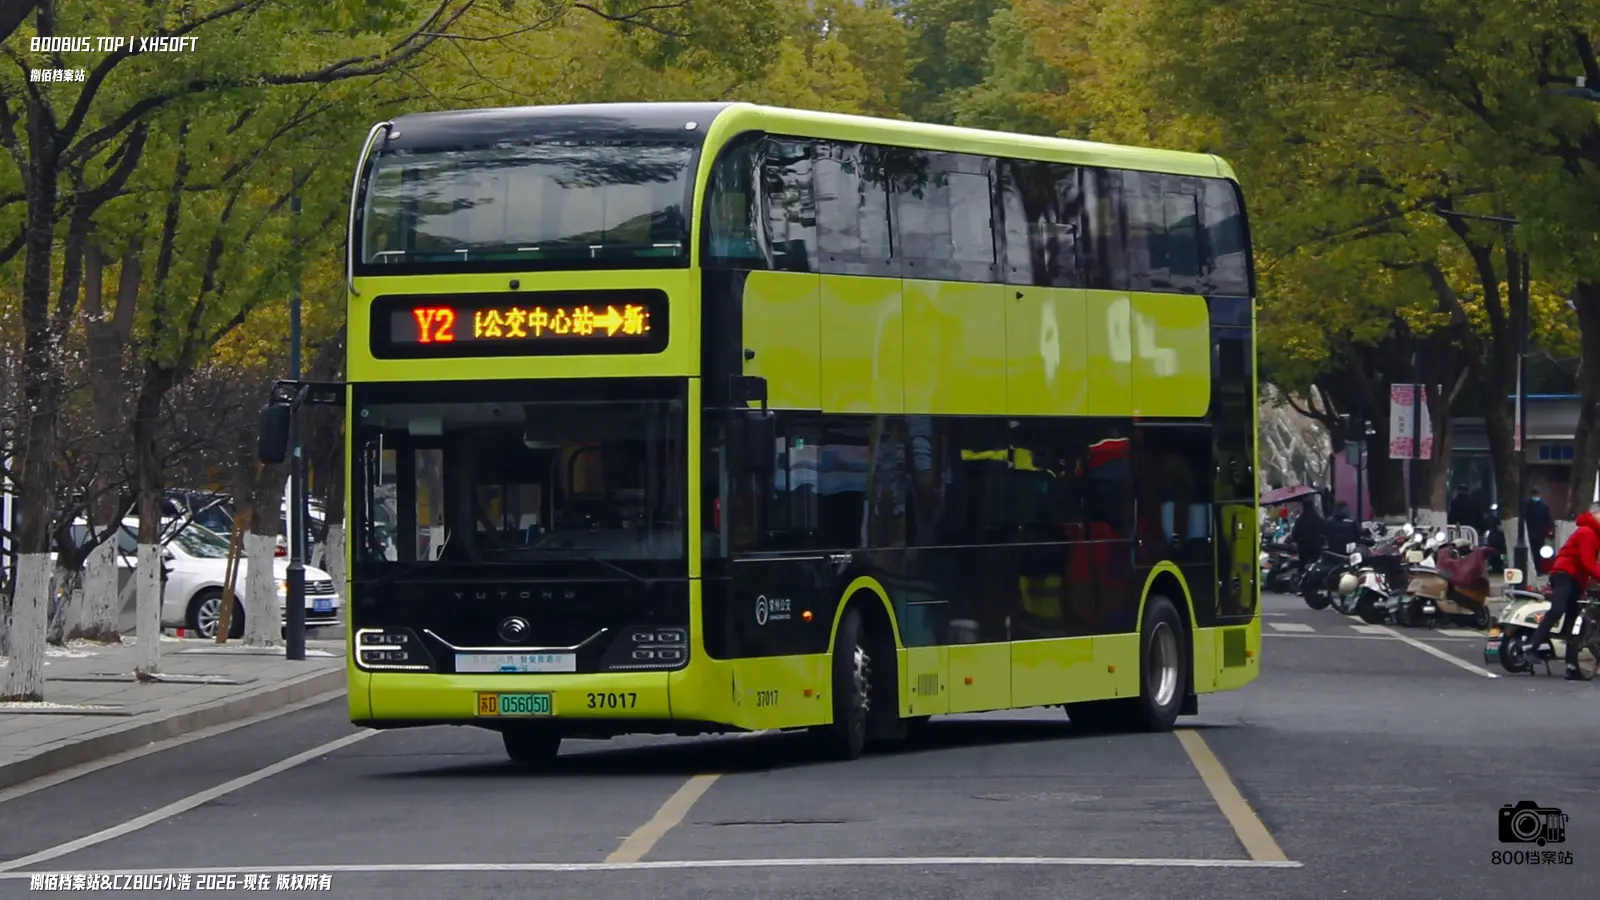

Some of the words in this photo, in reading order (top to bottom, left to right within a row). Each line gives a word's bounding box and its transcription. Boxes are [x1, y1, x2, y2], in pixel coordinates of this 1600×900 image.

[413, 307, 455, 343] Y2
[622, 304, 651, 335] 新
[587, 693, 637, 709] 37017
[757, 691, 779, 707] 37017
